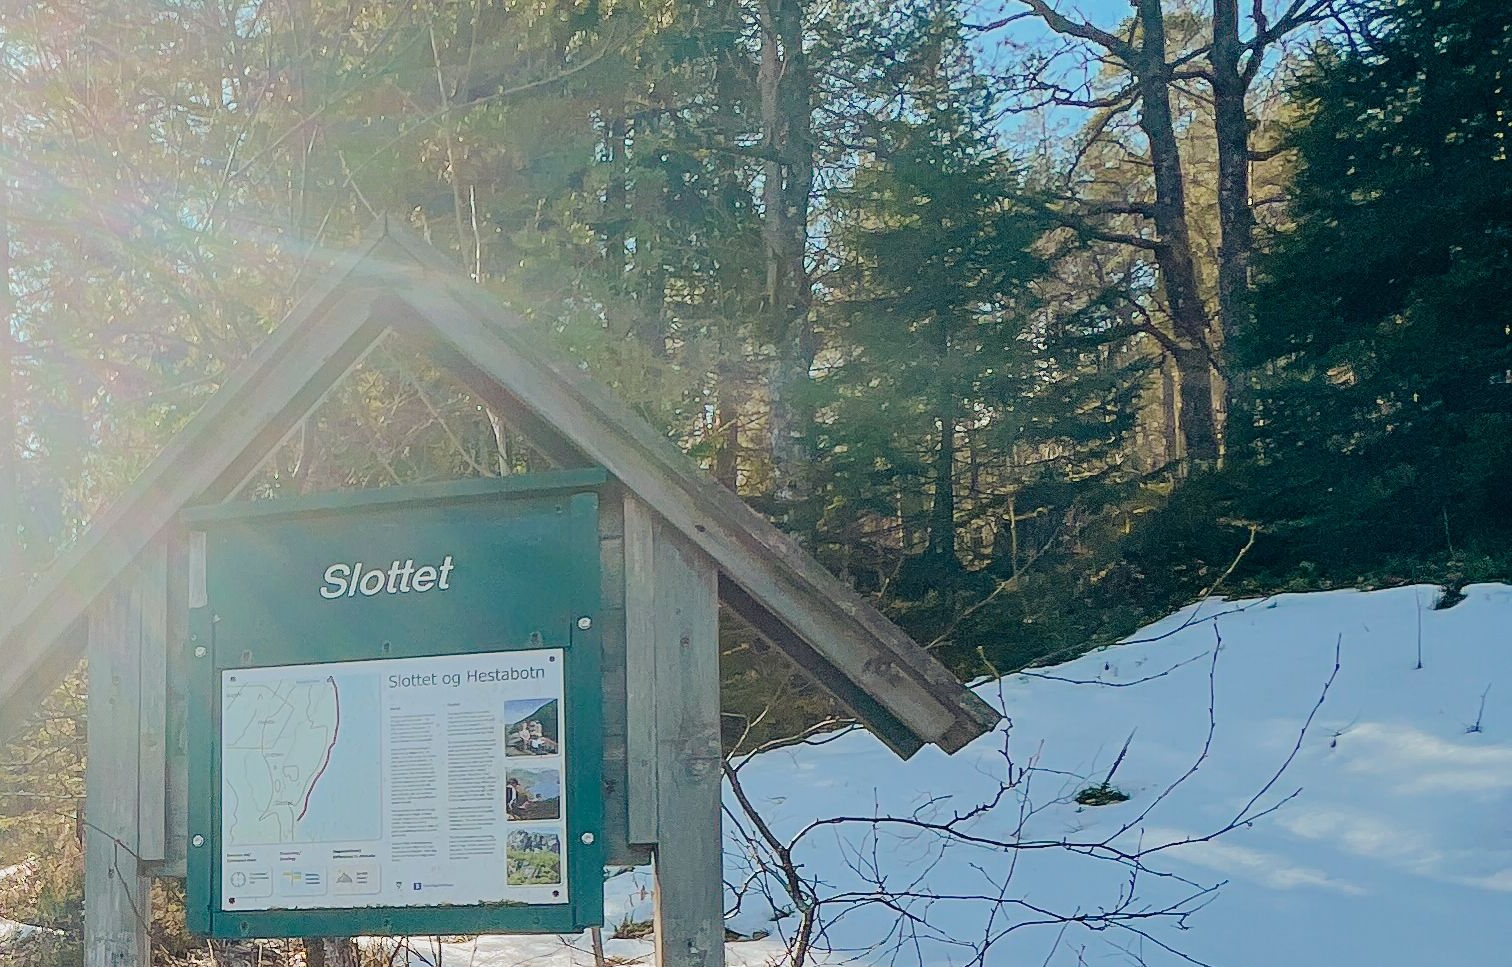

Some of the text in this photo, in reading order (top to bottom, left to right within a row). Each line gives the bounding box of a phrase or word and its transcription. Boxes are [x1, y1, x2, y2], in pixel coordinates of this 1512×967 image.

[319, 555, 455, 600] Slottet
[388, 666, 545, 689] Slottet og Hestabotn
